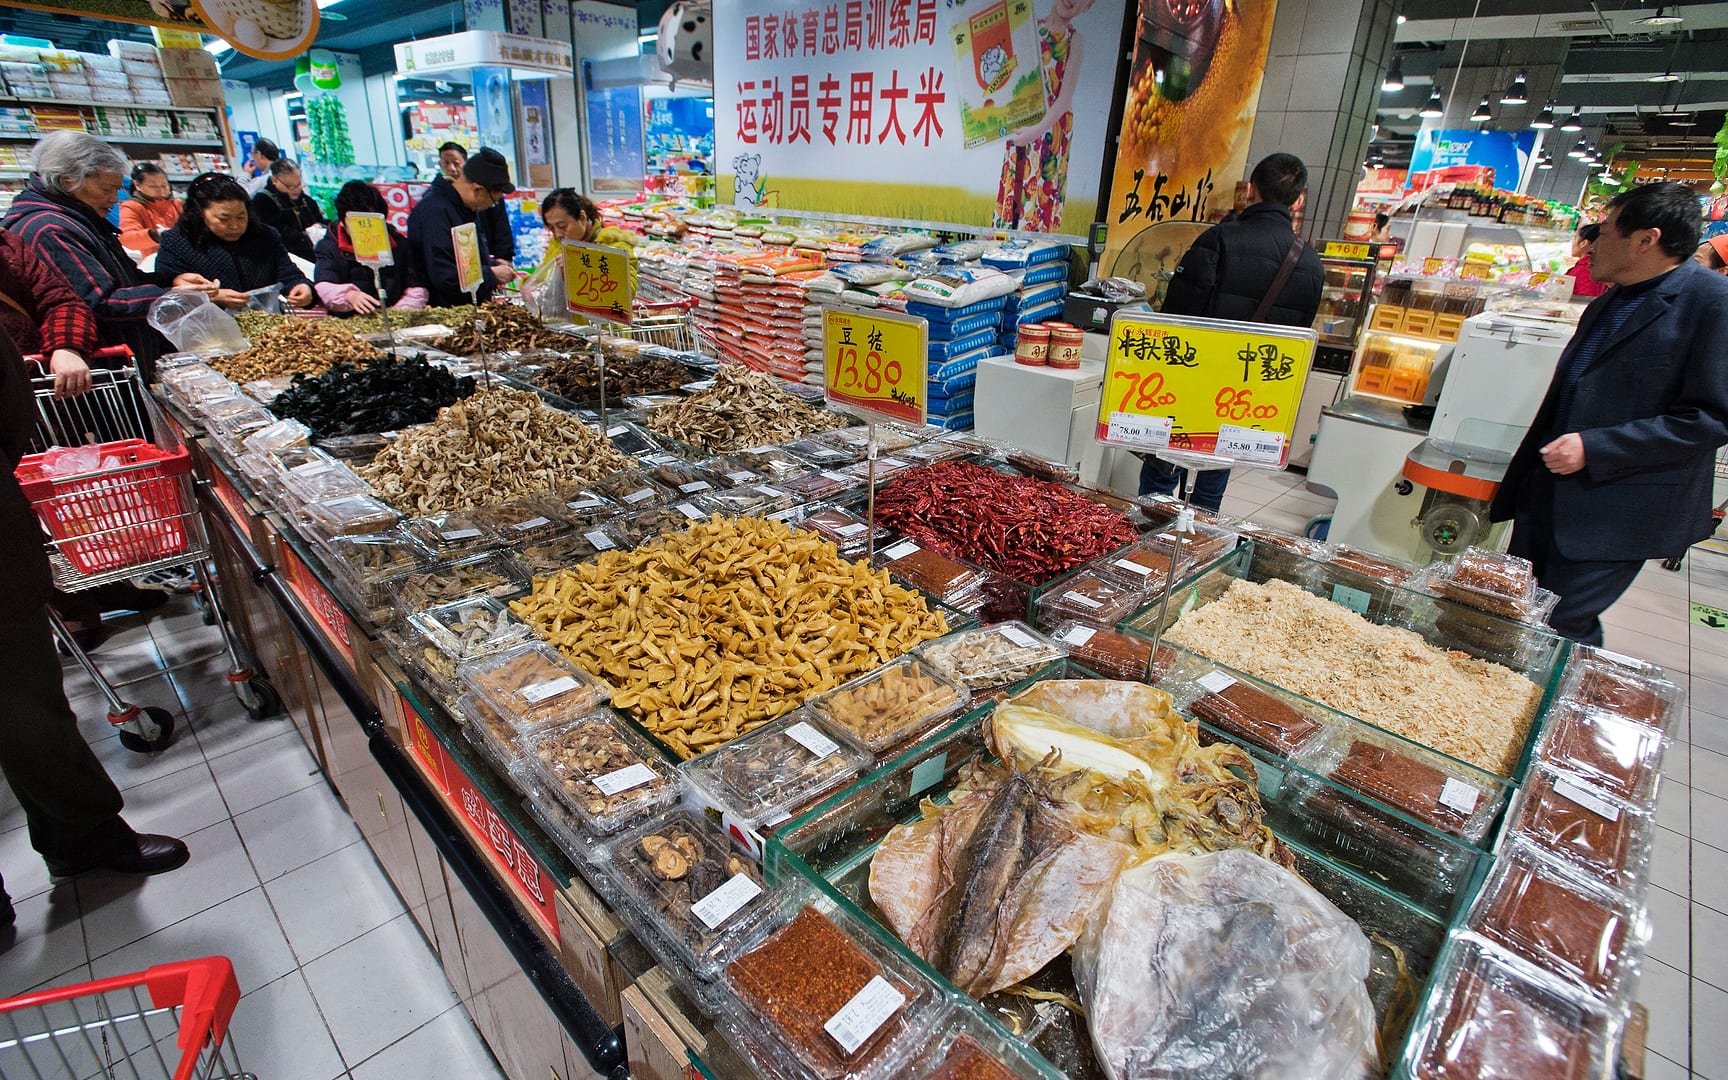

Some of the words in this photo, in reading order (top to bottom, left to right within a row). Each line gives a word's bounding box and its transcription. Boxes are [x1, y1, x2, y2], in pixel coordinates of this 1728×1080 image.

[745, 0, 937, 61] 国家体育总局训练局
[736, 66, 945, 147] 运动员专用大米
[833, 347, 902, 394] 13.80
[1114, 371, 1177, 412] 78.00
[1215, 387, 1278, 420] 85.00
[1119, 426, 1141, 436] 78.00
[1227, 441, 1251, 451] 35.80
[486, 807, 545, 903] 实惠
